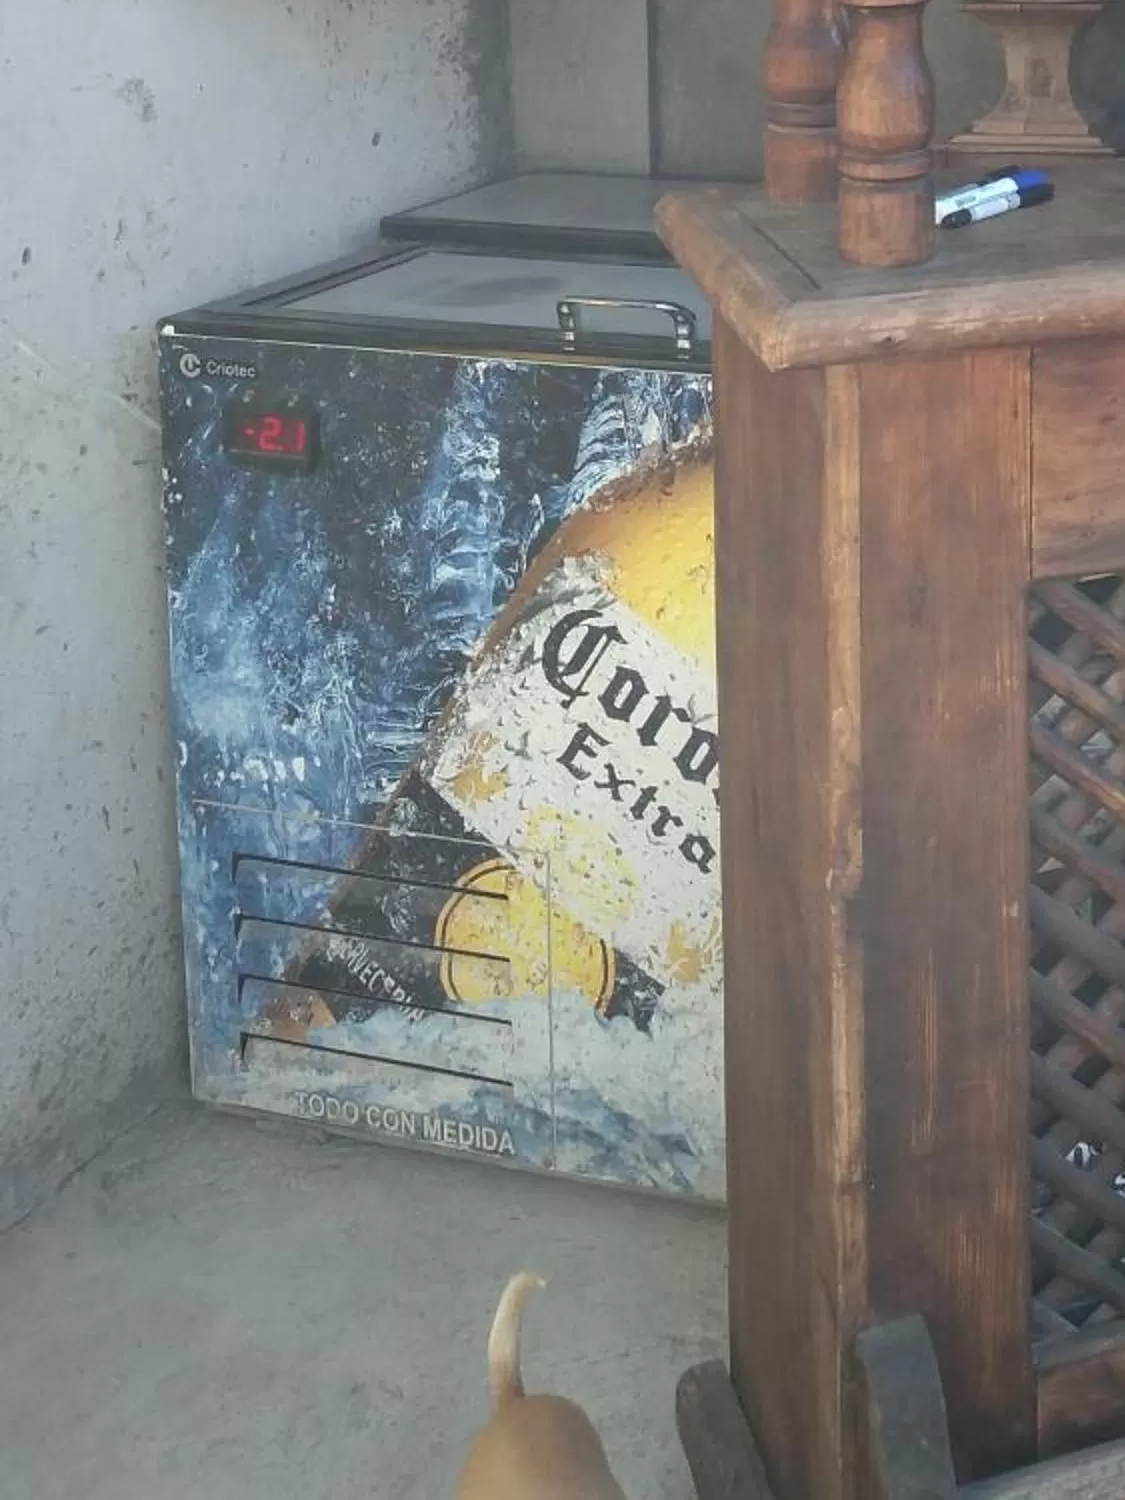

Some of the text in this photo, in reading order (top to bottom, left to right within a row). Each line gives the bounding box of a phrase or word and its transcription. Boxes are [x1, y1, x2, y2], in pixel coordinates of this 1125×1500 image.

[205, 359, 257, 378] Criotec
[541, 609, 720, 806] Coro
[556, 722, 716, 874] Extra
[295, 1091, 516, 1155] TODO CON MEDIDA
